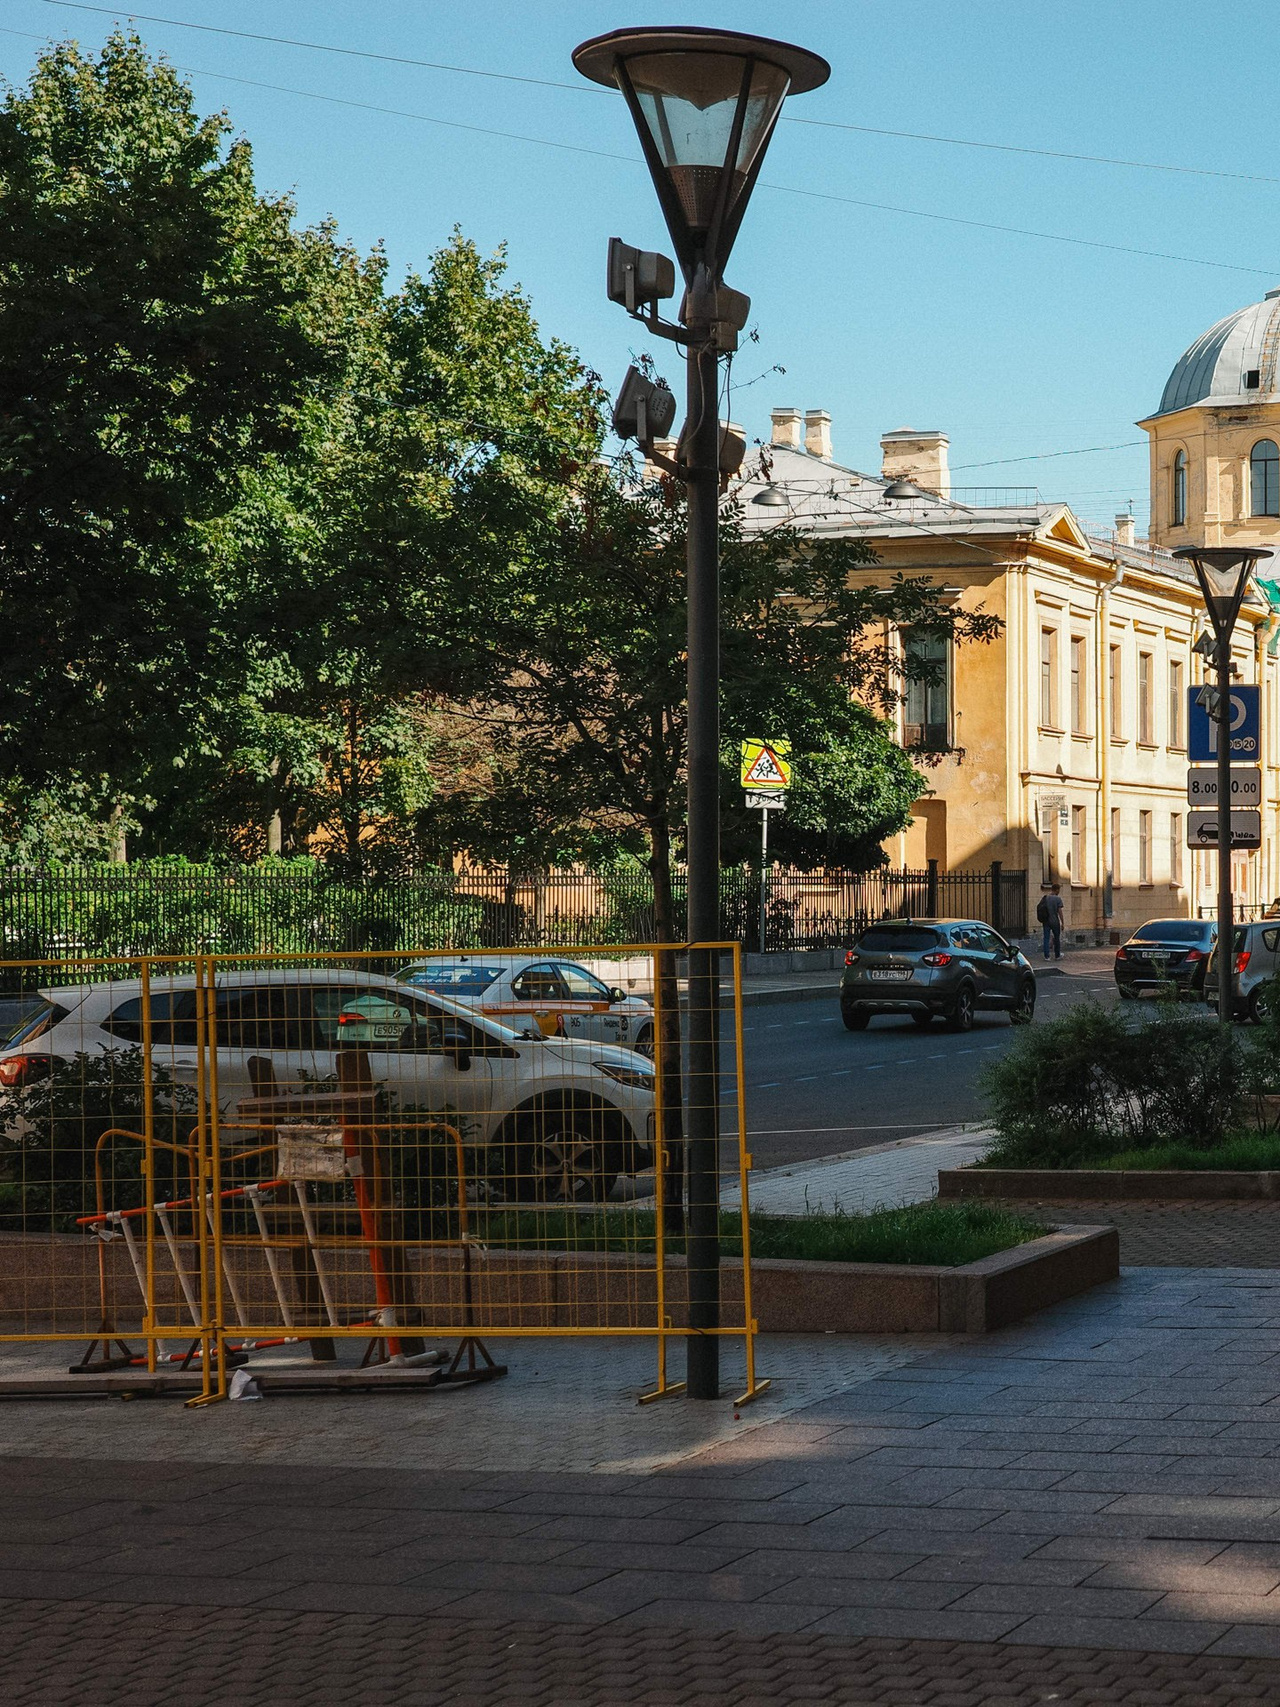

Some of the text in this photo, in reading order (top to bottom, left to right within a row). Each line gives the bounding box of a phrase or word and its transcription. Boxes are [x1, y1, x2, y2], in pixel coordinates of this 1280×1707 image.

[1243, 738, 1255, 748] 20
[571, 1016, 581, 1027] 905
[377, 1025, 403, 1034] Е905Н
